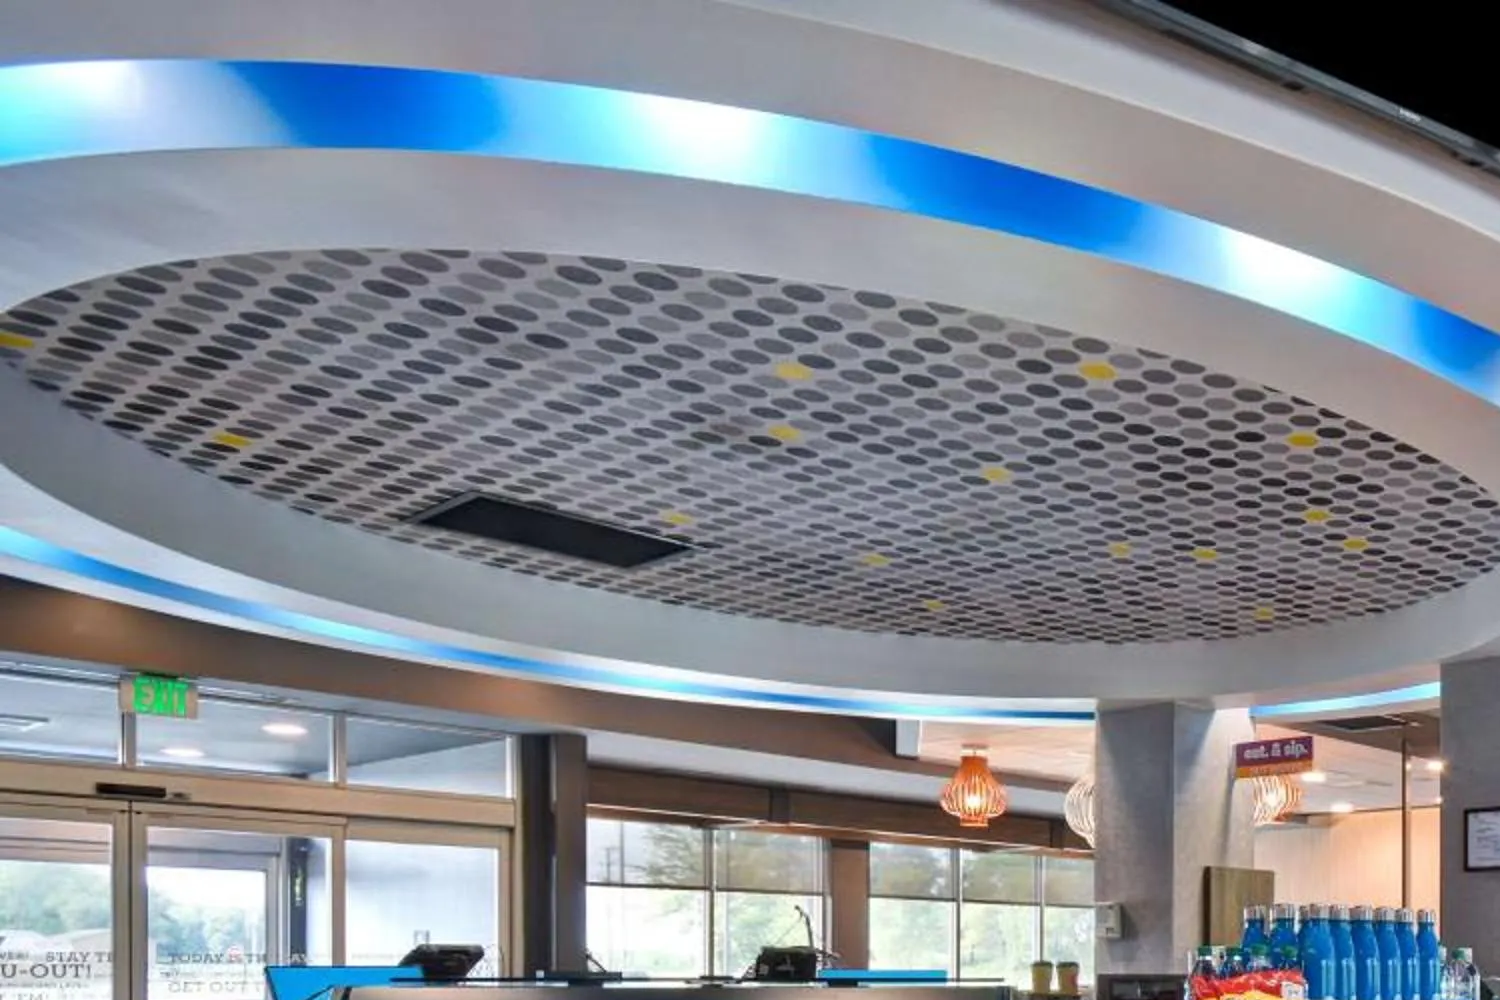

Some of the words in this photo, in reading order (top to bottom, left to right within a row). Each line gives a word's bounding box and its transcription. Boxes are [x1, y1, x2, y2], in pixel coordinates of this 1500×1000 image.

[134, 677, 188, 716] EXIT
[46, 951, 90, 963] STAY
[168, 952, 224, 964] TODAY
